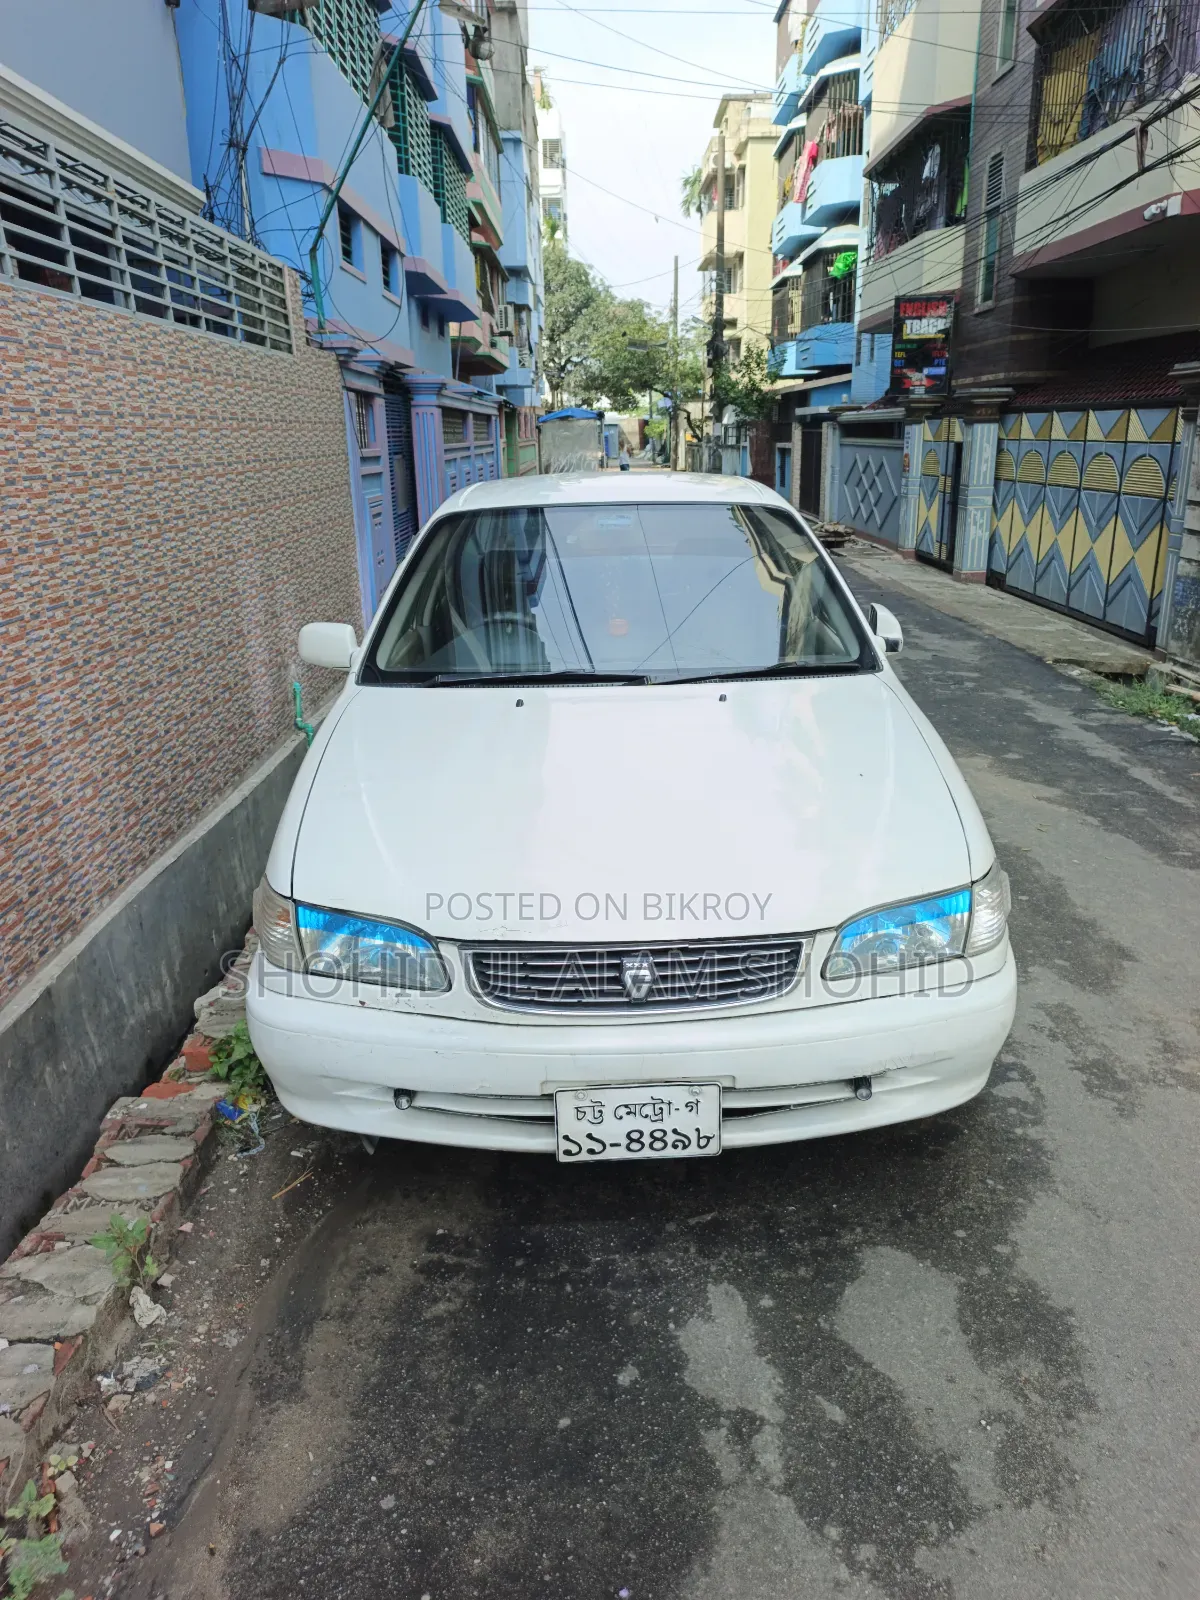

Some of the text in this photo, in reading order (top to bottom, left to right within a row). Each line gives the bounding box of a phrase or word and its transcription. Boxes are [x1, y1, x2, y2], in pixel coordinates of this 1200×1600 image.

[900, 301, 947, 317] ENGLISH
[574, 1099, 606, 1124] চট্ট
[562, 1127, 716, 1156] ১১-৪৪৯৮
